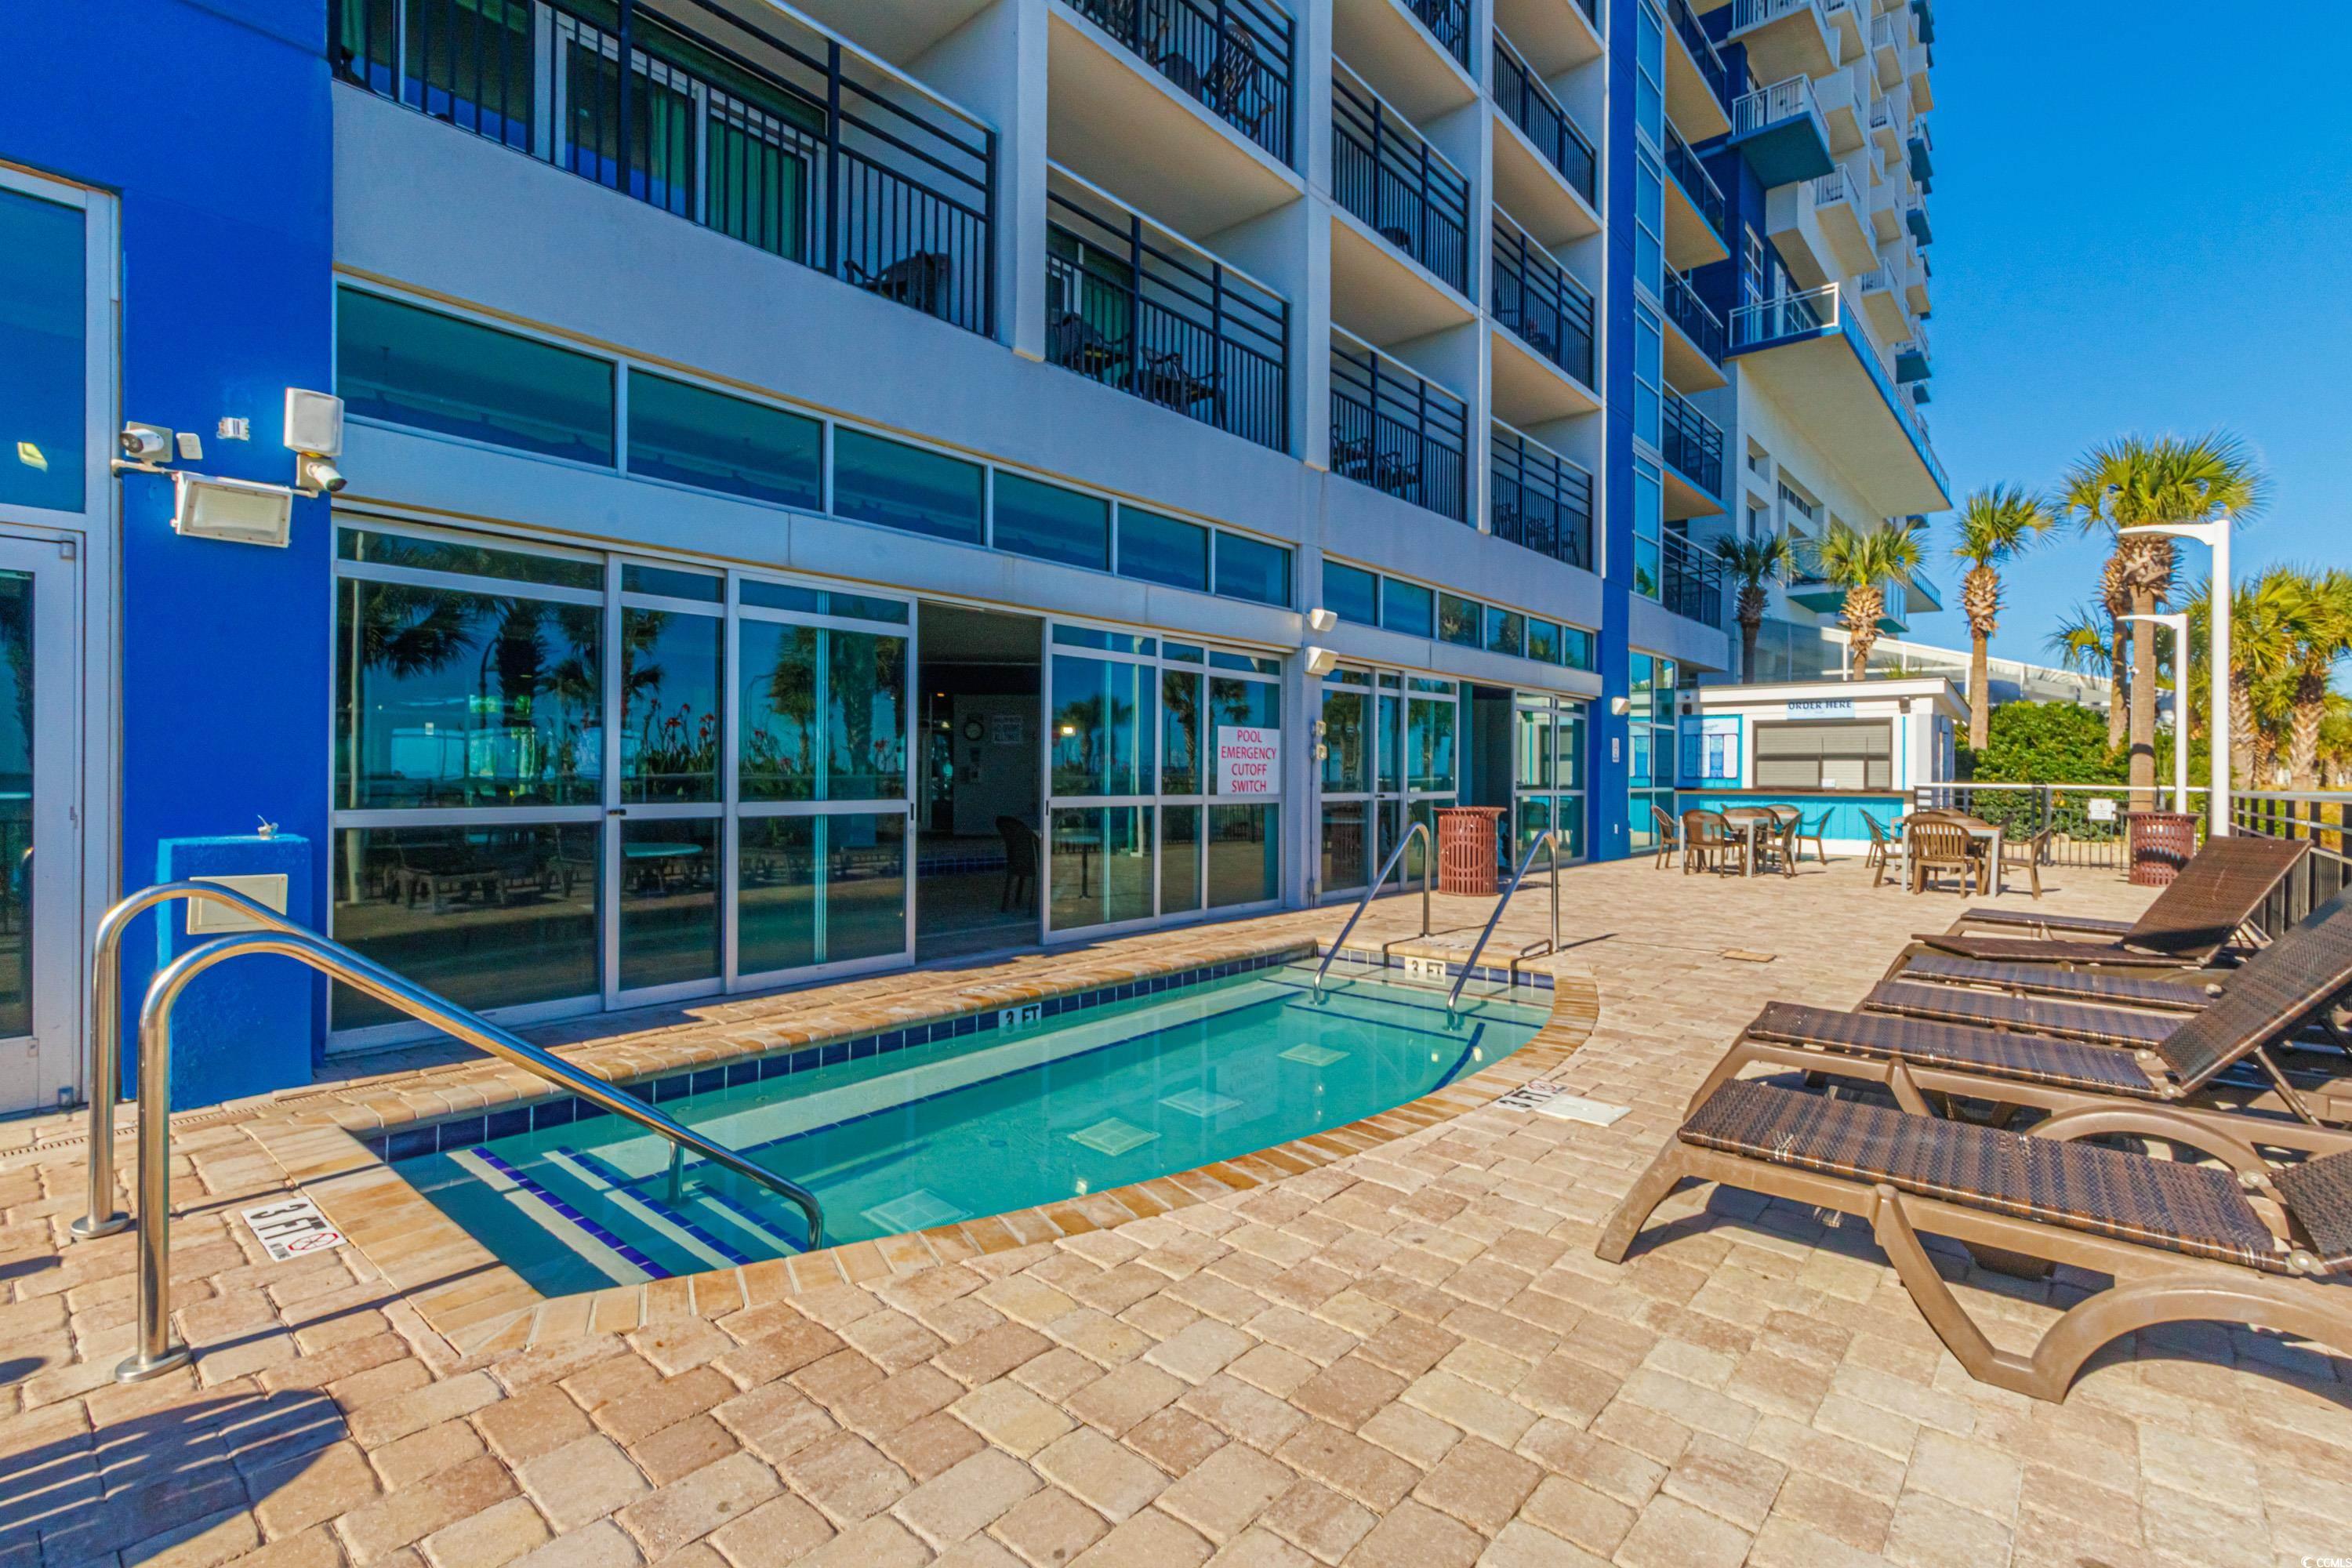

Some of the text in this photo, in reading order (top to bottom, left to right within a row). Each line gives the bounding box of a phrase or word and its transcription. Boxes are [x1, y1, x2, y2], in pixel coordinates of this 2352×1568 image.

[1788, 699, 1852, 710] ORDER HERE
[1237, 730, 1262, 743] POOL
[1221, 746, 1276, 759] EMERGENCY
[1231, 763, 1267, 776] CUTOFF
[1232, 780, 1267, 793] SWITCH
[1022, 1004, 1040, 1022] FT
[1511, 1089, 1552, 1103] FT
[249, 1203, 327, 1240] 3 FT
